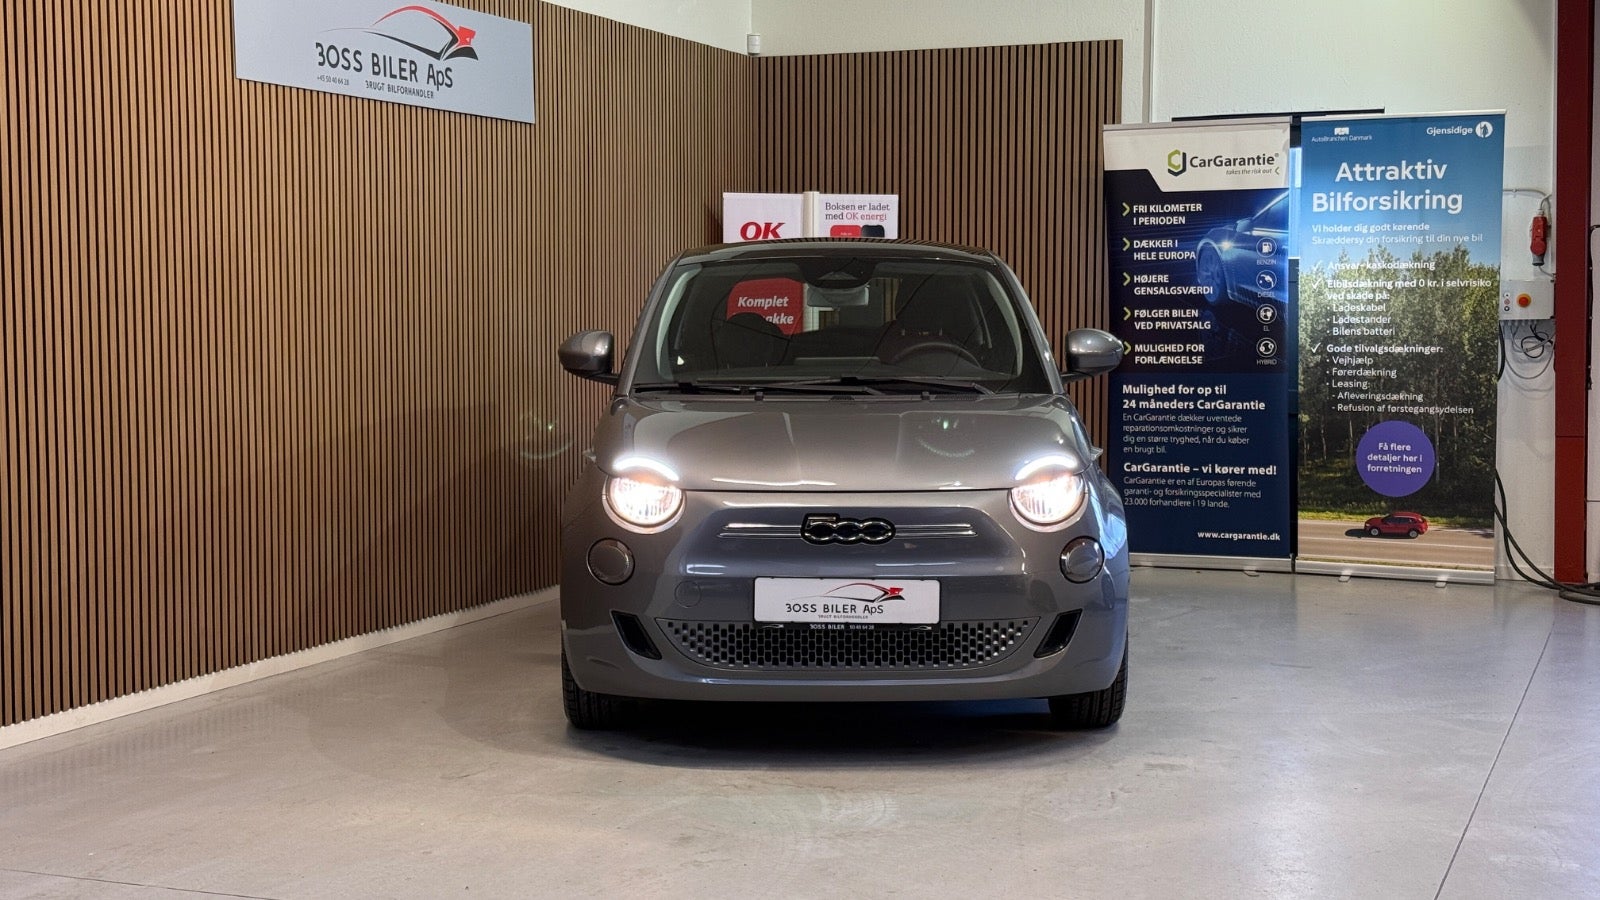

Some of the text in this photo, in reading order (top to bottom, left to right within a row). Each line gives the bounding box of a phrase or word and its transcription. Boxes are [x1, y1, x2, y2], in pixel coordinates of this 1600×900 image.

[372, 53, 418, 82] BILER
[427, 64, 453, 91] ApS
[388, 84, 434, 99] BILFORHANDLER
[1427, 126, 1473, 137] Gjensidige
[1335, 159, 1447, 182] Attraktiv
[1313, 189, 1462, 214] Bilforsikring
[825, 203, 855, 211] Boksen
[868, 203, 890, 211] ladet
[1134, 204, 1202, 213] FRI KILOMETER
[825, 212, 843, 220] med
[861, 212, 887, 222] energi
[1139, 217, 1185, 225] PERIODEN
[740, 222, 785, 241] OK
[1312, 223, 1430, 234] Vi holder dig godt kørende
[1134, 240, 1172, 248] DÆKKER
[1312, 236, 1364, 246] Skræddersy
[1367, 235, 1380, 244] din
[1382, 235, 1424, 245] forsikring
[1425, 234, 1435, 243] til
[1437, 234, 1450, 242] din
[1453, 235, 1469, 244] nye
[1134, 252, 1196, 260] HELE EUROPA
[1366, 260, 1435, 271] kaskodækning
[1134, 274, 1169, 283] HØJERE
[1328, 279, 1393, 289] Elbilsdækning
[1395, 279, 1416, 288] med
[1419, 279, 1425, 287] 0
[1427, 279, 1439, 287] kr.
[1446, 278, 1491, 287] selvrisiko
[1134, 286, 1213, 295] GENSALGSVÆRDI
[1326, 291, 1390, 301] ved skade på:
[738, 296, 789, 310] Komplet
[1333, 303, 1386, 312] Ladeskabel
[1134, 309, 1170, 318] FØLGER
[1333, 315, 1391, 324] Ladestander
[1134, 322, 1211, 330] VED PRIVATSALG
[1333, 327, 1395, 336] Bilens batteri
[1135, 344, 1205, 352] MULIGHED FOR
[1327, 344, 1443, 354] Gode tilvalgsdækninger:
[1135, 356, 1203, 364] FORLÆNGELSE
[1332, 356, 1373, 366] Vejhjælp
[1332, 368, 1397, 378] Førerdækning
[1123, 384, 1226, 397] Mulighed for op til
[1337, 392, 1424, 402] Afleveringsdækning
[1123, 399, 1266, 410] 24 måneders CarGarantie
[1337, 404, 1474, 415] Refusion af førstegangsydelsen
[1134, 414, 1176, 422] CarGarantie
[1123, 425, 1214, 434] reparationsomkostninger
[1123, 435, 1134, 444] dig
[1170, 436, 1201, 445] tryghed,
[1202, 436, 1214, 444] når
[1216, 436, 1226, 444] du
[1228, 436, 1249, 444] køber
[1134, 445, 1154, 455] brugt
[1156, 445, 1166, 454] bil.
[1378, 442, 1411, 451] Få flere
[1367, 454, 1401, 463] detaljer
[1124, 462, 1190, 473] CarGarantie
[1202, 464, 1212, 474] vi
[1215, 464, 1246, 474] kører
[1248, 465, 1277, 475] med!
[1367, 464, 1422, 474] forretningen
[1124, 477, 1166, 485] CarGarantie
[1196, 479, 1225, 488] Europas
[1227, 479, 1256, 487] førende
[1124, 488, 1151, 496] garanti-
[1165, 488, 1242, 498] forsikringsspecialister
[1149, 498, 1191, 507] forhandlere
[1207, 500, 1230, 508] lande.
[802, 514, 895, 544] 500
[1198, 531, 1280, 541] www.cargarantie.dk
[823, 604, 856, 613] BILER
[863, 604, 883, 615] ApS
